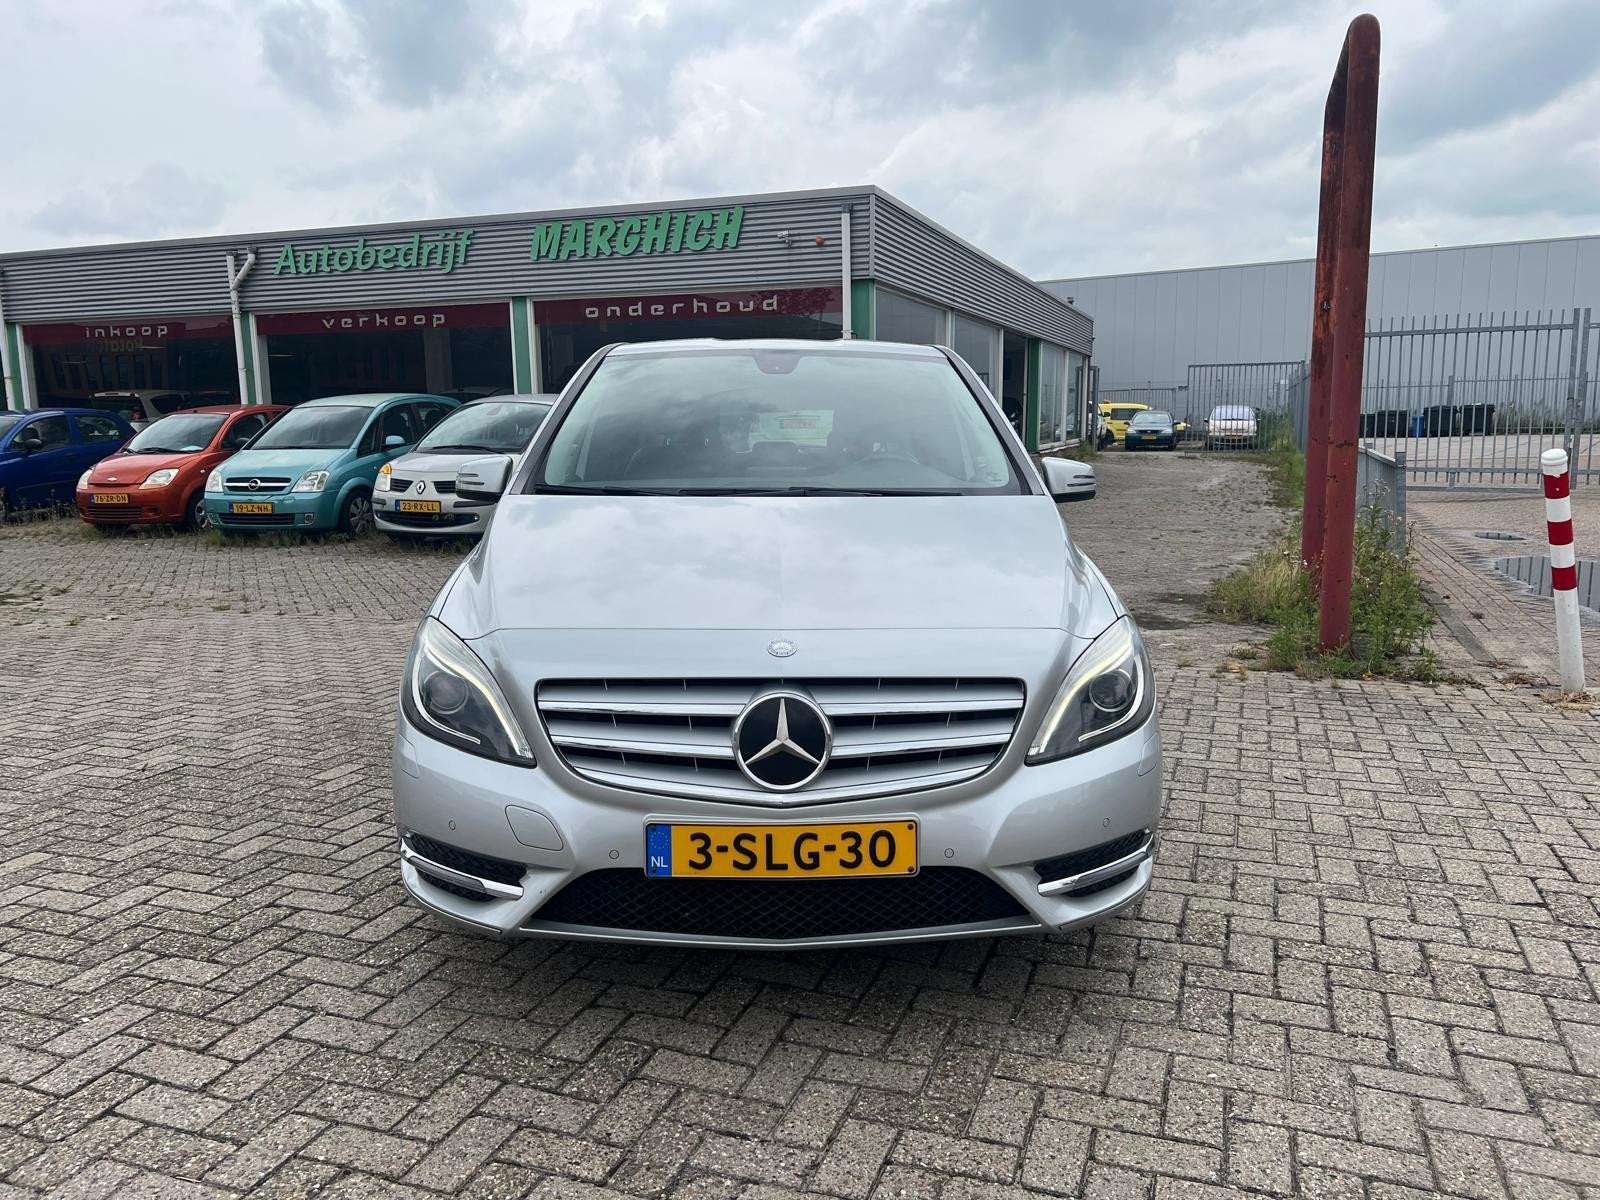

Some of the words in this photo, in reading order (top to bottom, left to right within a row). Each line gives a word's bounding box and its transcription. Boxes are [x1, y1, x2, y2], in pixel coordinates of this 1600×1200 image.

[273, 228, 475, 275] Autobedrijf
[585, 295, 778, 318] onderhoud
[322, 313, 446, 329] verkoop
[85, 325, 169, 338] inkoop
[235, 504, 269, 513] 19-LZ-NH
[402, 502, 437, 511] 23-RX-LL
[688, 830, 896, 871] 3-SLG-30
[651, 856, 668, 868] NL
